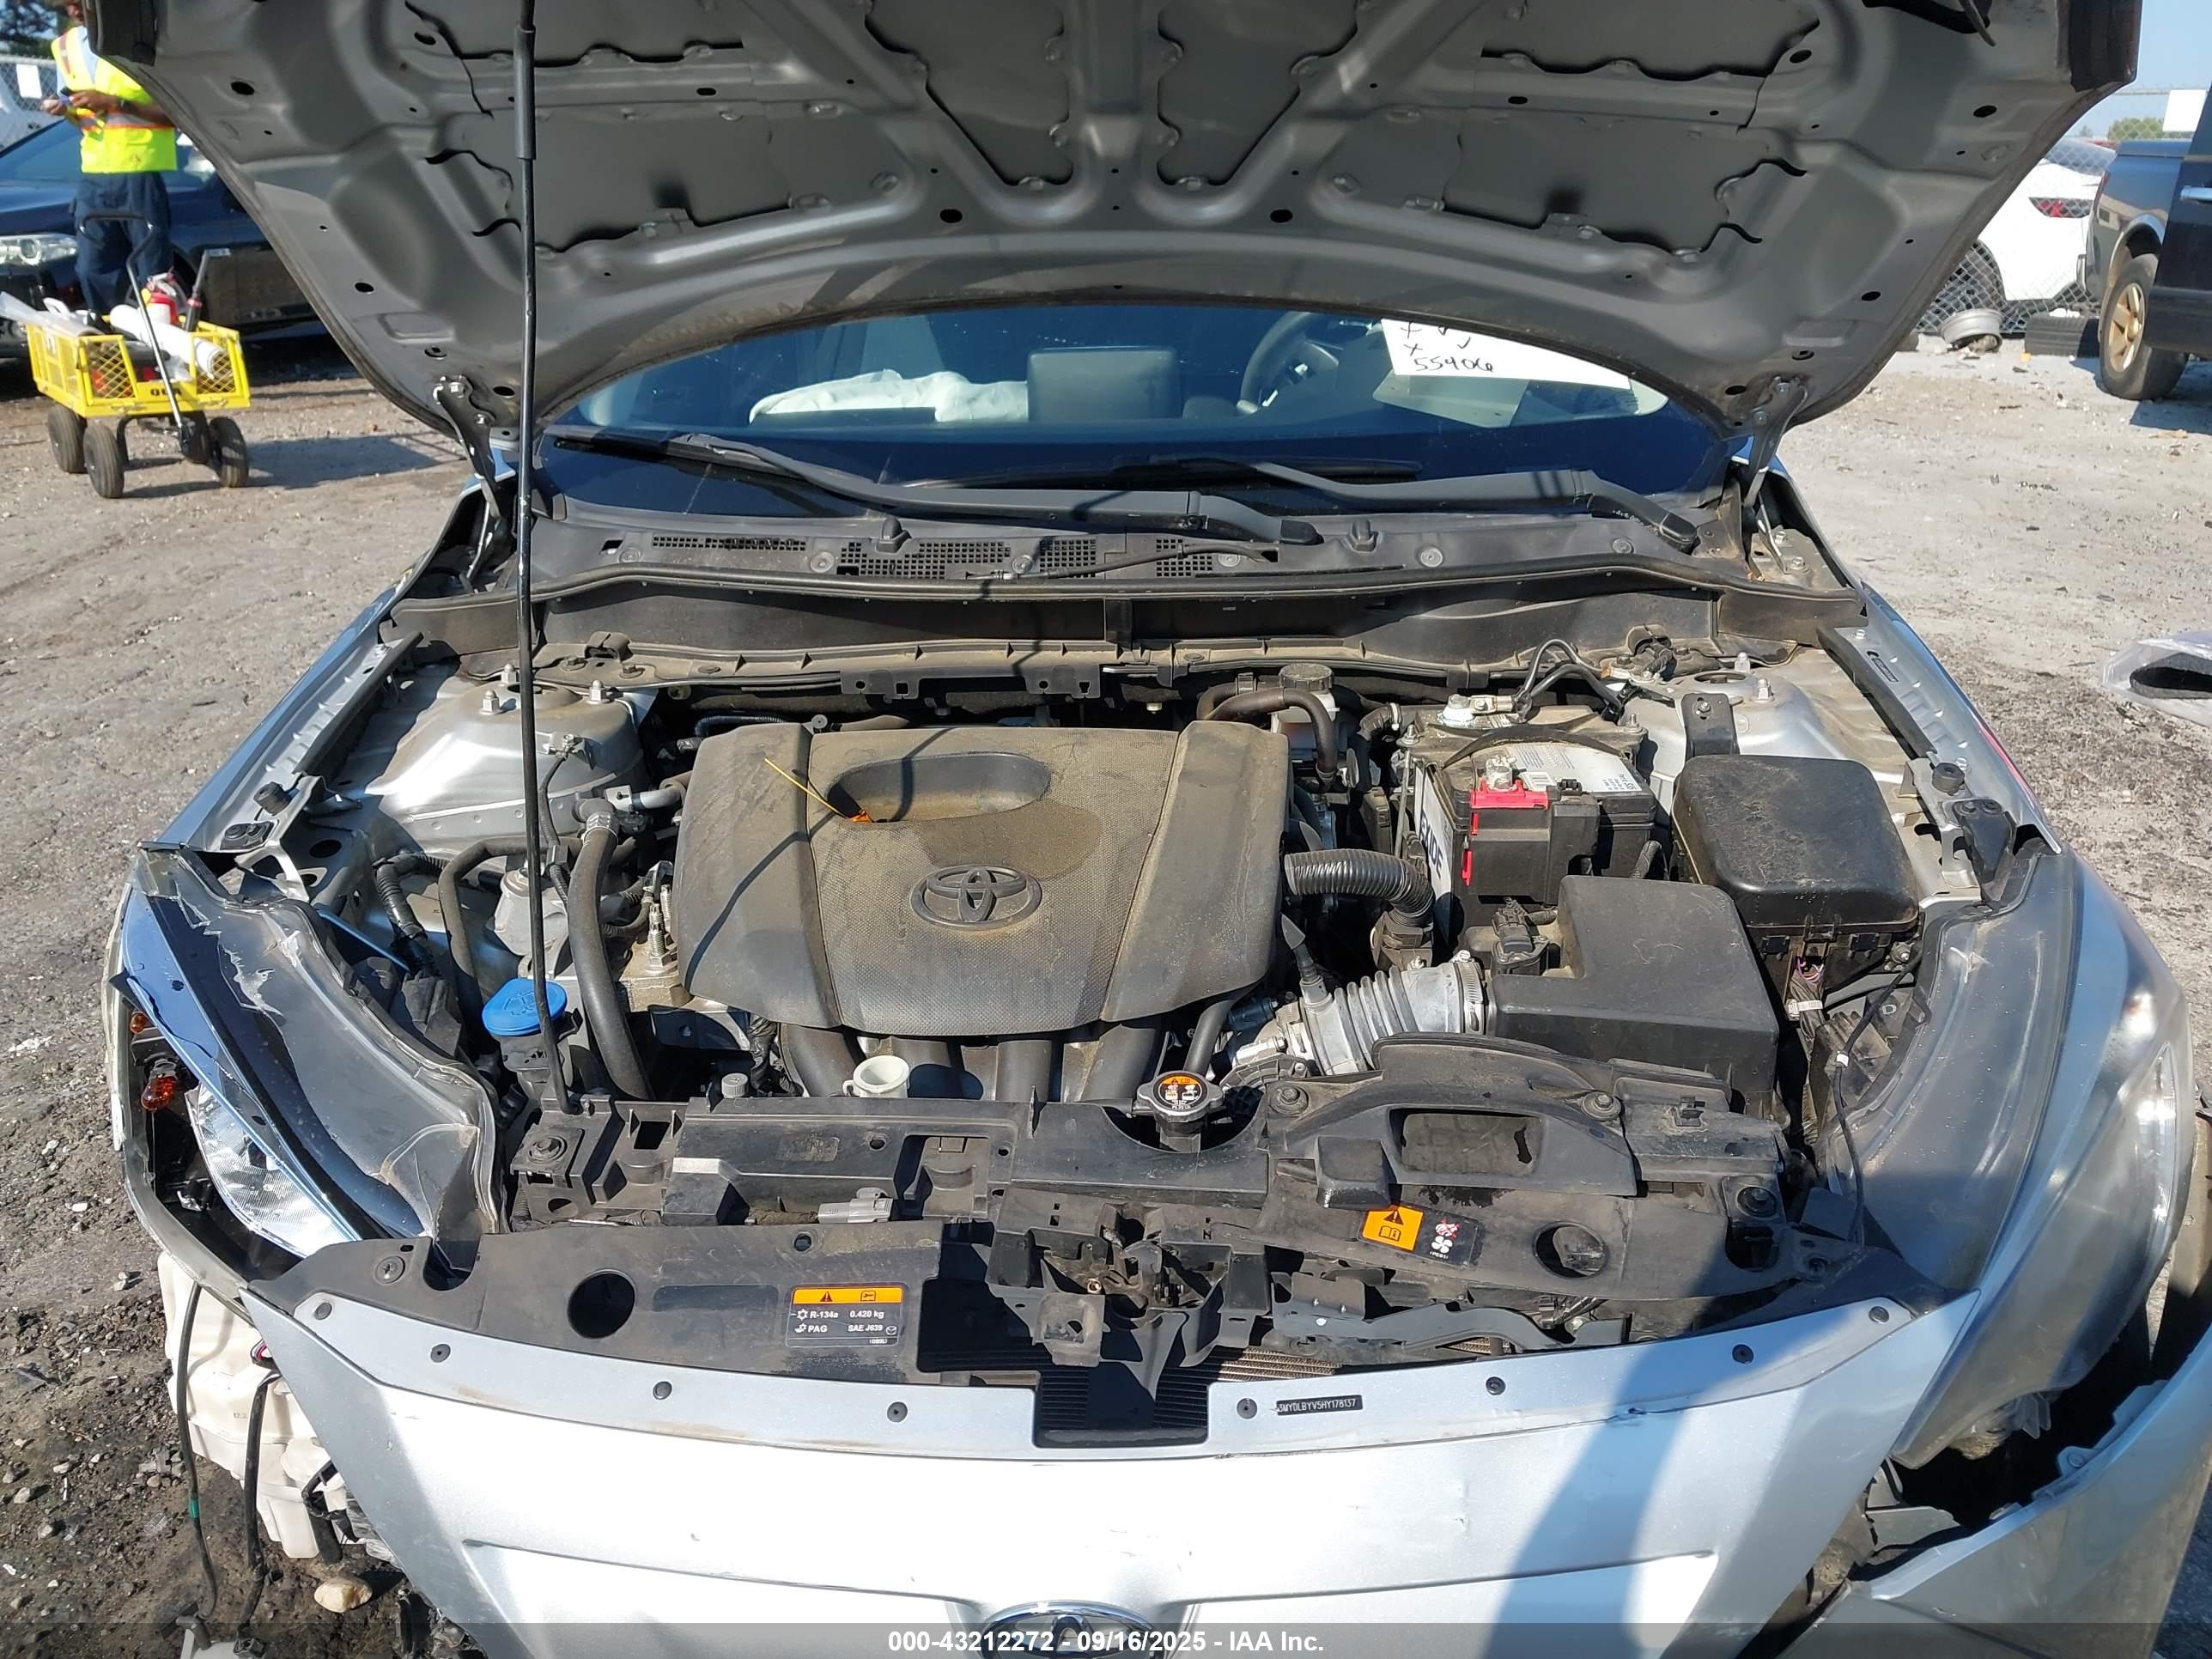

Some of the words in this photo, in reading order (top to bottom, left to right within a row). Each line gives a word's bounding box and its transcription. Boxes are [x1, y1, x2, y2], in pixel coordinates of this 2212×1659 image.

[1413, 356, 1493, 373] 55406
[809, 1310, 839, 1319] R-134a
[849, 1310, 872, 1319] 0.420
[873, 1310, 884, 1319] kg
[807, 1325, 828, 1334] PAG
[848, 1324, 865, 1333] SAE
